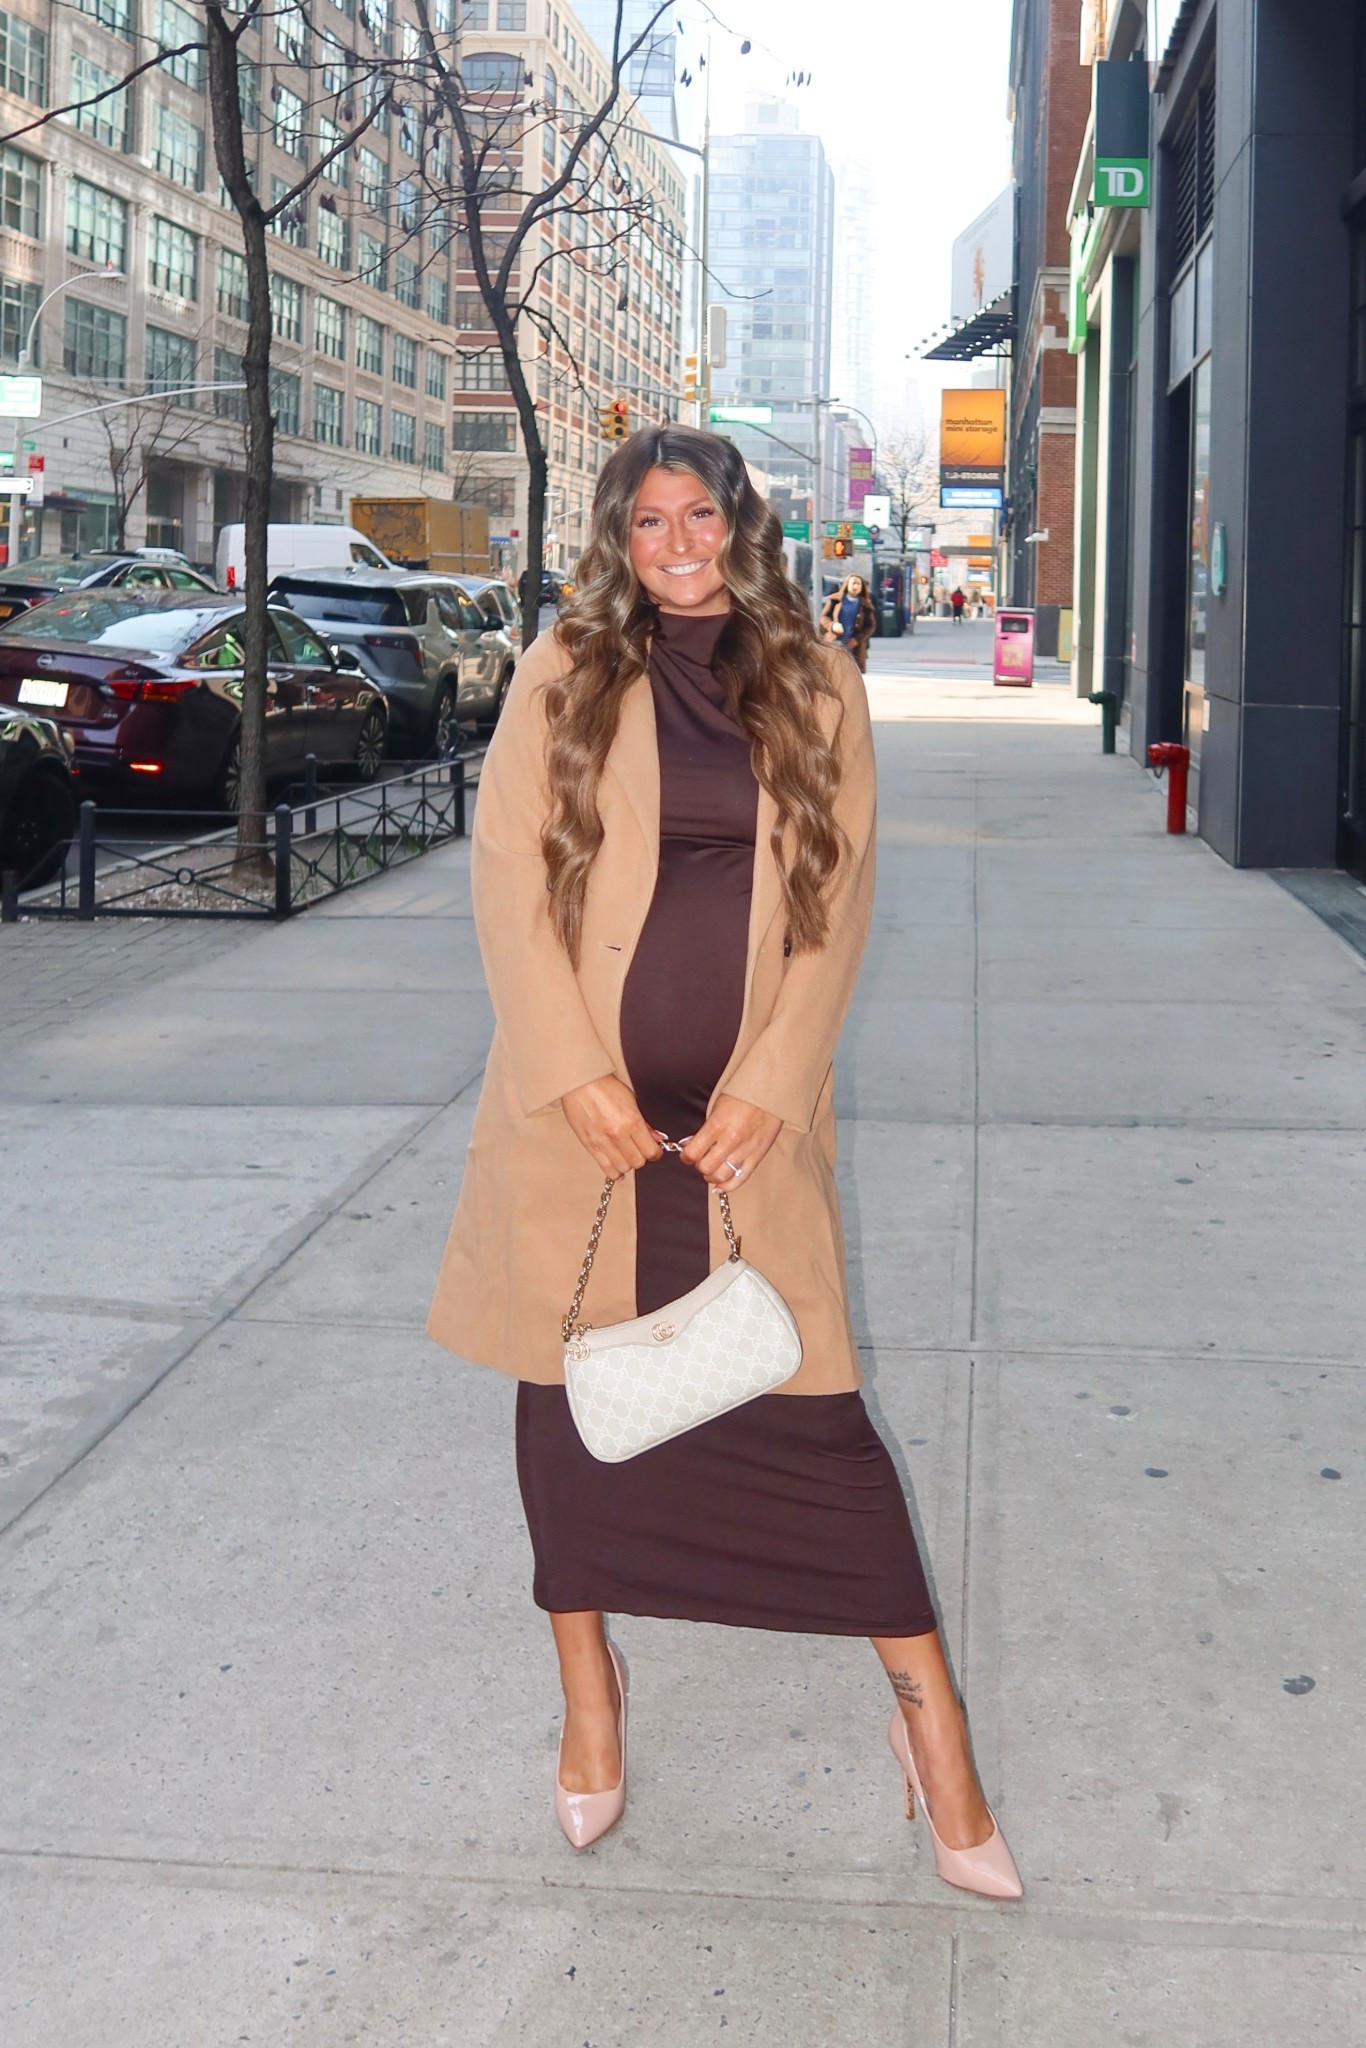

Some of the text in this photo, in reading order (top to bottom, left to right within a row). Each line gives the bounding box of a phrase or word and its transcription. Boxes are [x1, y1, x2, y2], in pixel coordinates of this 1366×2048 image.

[1099, 167, 1143, 196] TD
[946, 417, 992, 425] manhattan
[965, 426, 997, 434] storage
